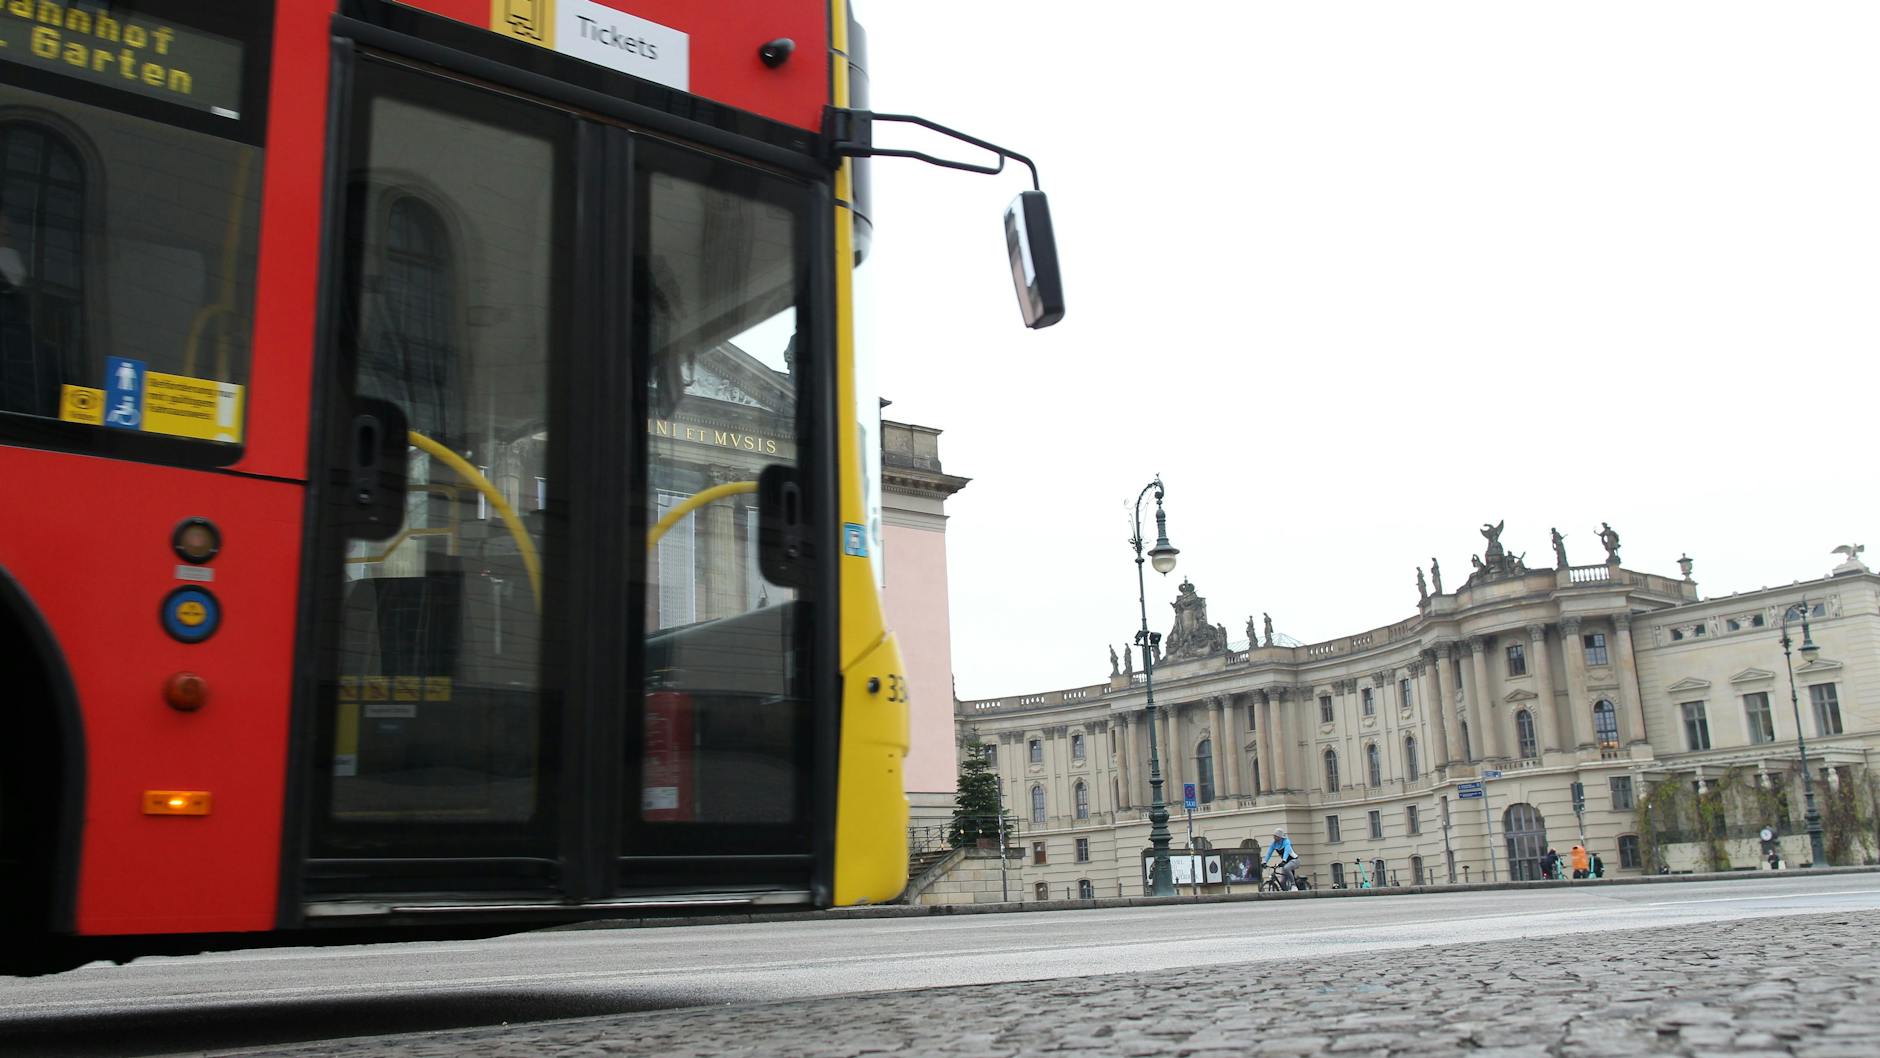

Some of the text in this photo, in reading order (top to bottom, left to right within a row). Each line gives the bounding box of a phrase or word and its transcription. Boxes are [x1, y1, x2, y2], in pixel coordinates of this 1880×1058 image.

[0, 0, 175, 55] ahnhof
[576, 15, 658, 60] Tickets
[31, 25, 192, 94] Garten
[686, 427, 705, 442] ET
[714, 430, 776, 454] MVSIS
